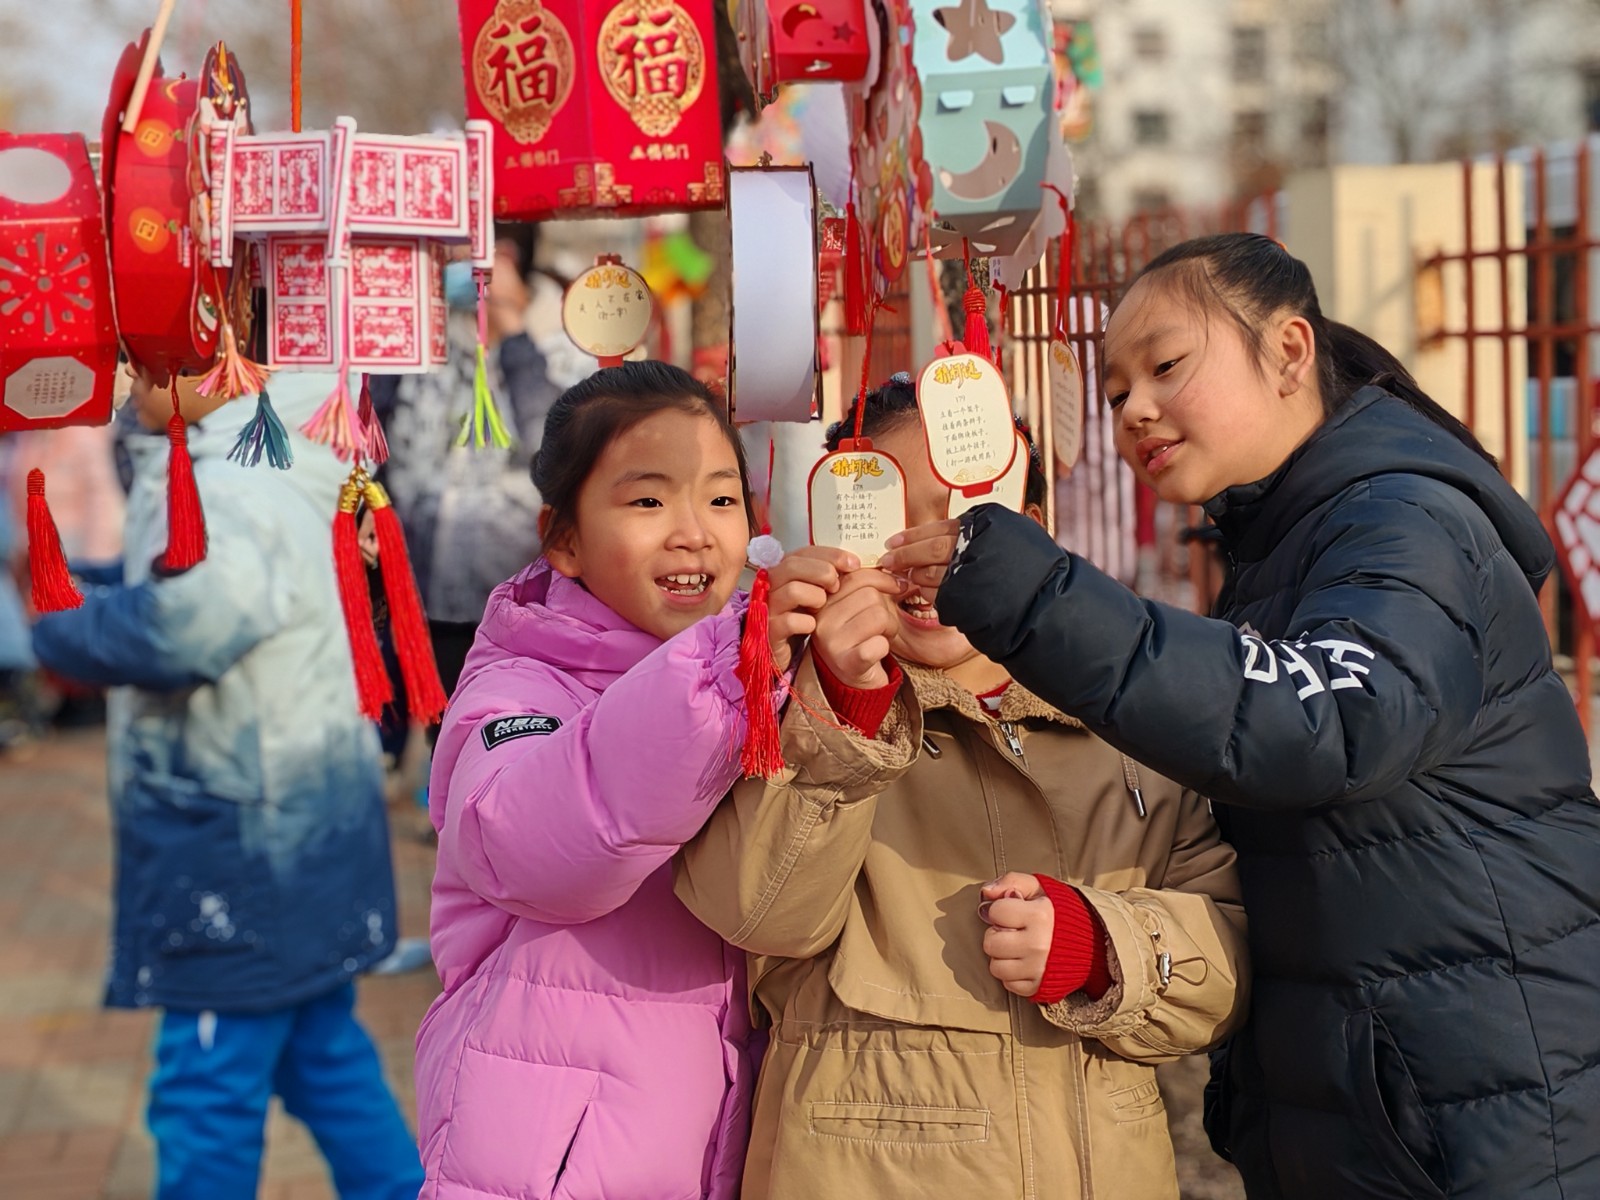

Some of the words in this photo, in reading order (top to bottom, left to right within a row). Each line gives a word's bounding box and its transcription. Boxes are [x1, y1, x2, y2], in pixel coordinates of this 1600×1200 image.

[486, 14, 558, 111] 福
[613, 10, 689, 99] 福
[934, 359, 982, 389] 猜灯谜
[830, 457, 884, 482] 猜灯谜
